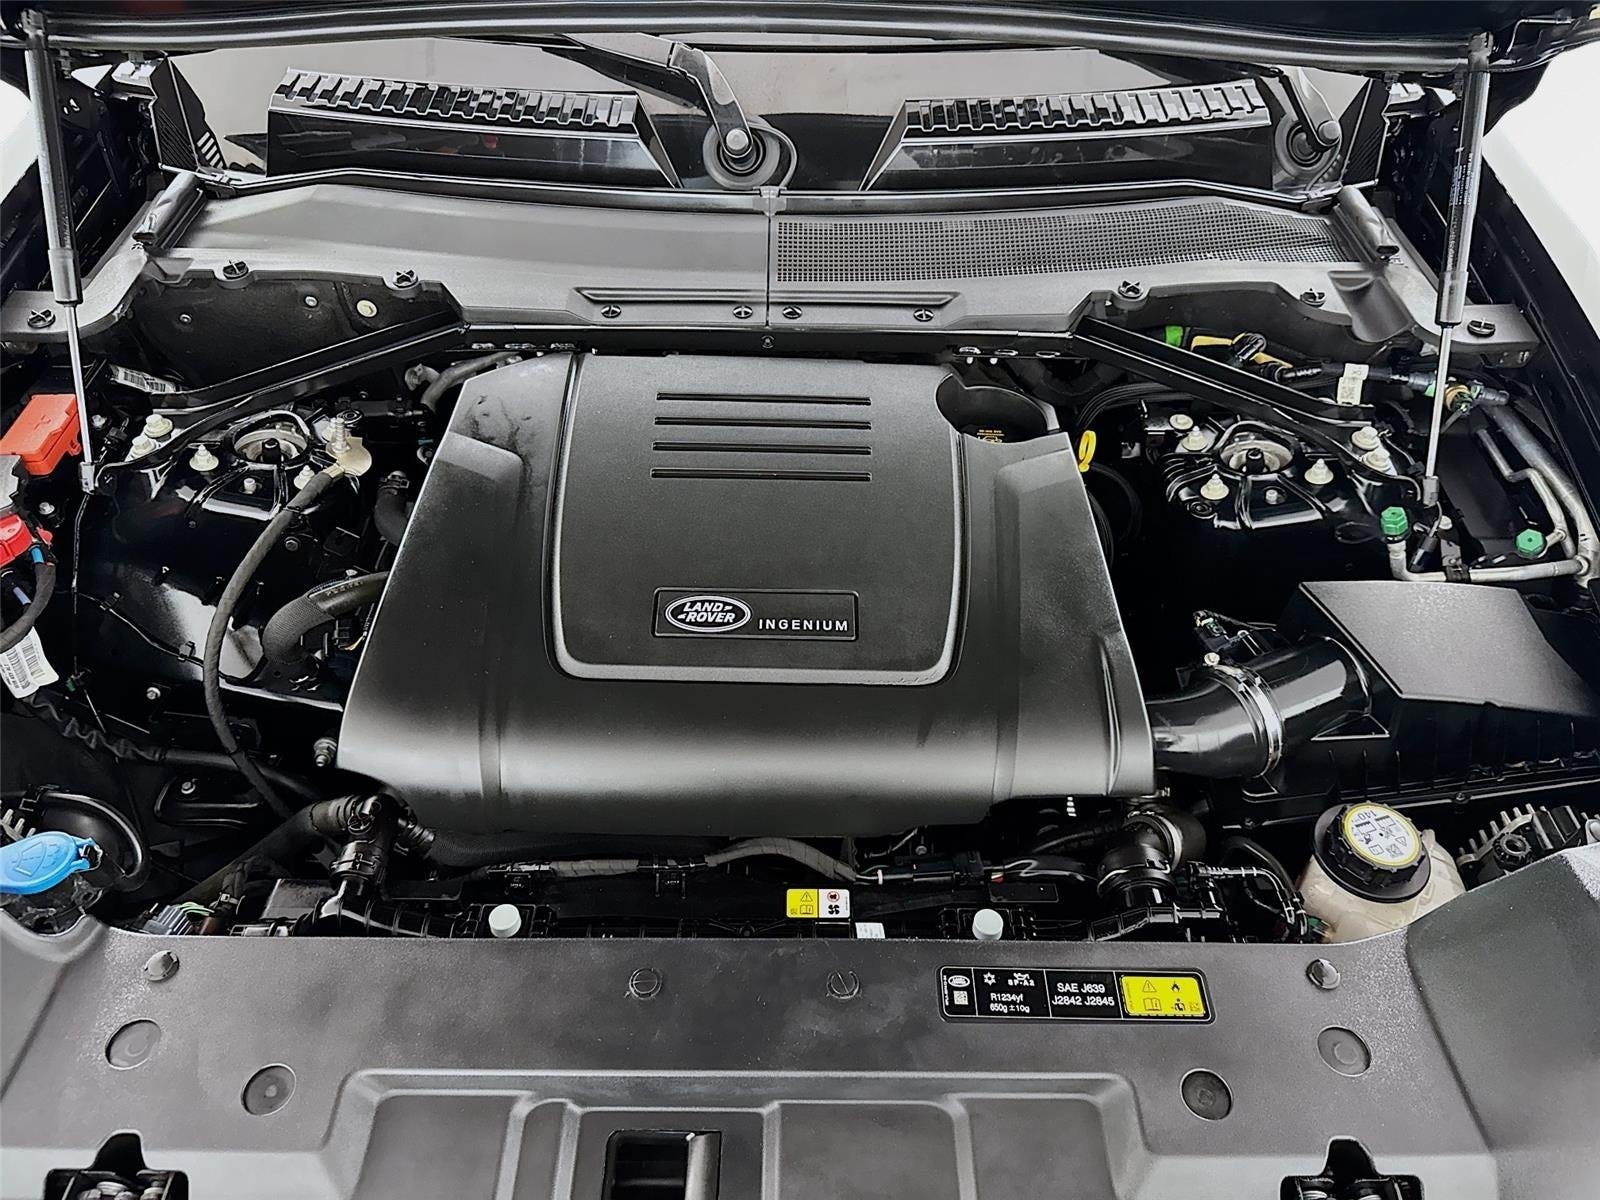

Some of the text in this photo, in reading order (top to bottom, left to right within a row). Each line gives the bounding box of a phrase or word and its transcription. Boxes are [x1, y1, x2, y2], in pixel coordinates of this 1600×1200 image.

[684, 602, 723, 612] LAND
[685, 612, 736, 623] ROVER
[758, 619, 848, 632] INGENIUM
[1057, 983, 1106, 994] SAE J639
[990, 993, 1024, 1002] R1234yf
[1052, 995, 1114, 1007] J2842 J2845
[990, 1003, 1008, 1013] 650g
